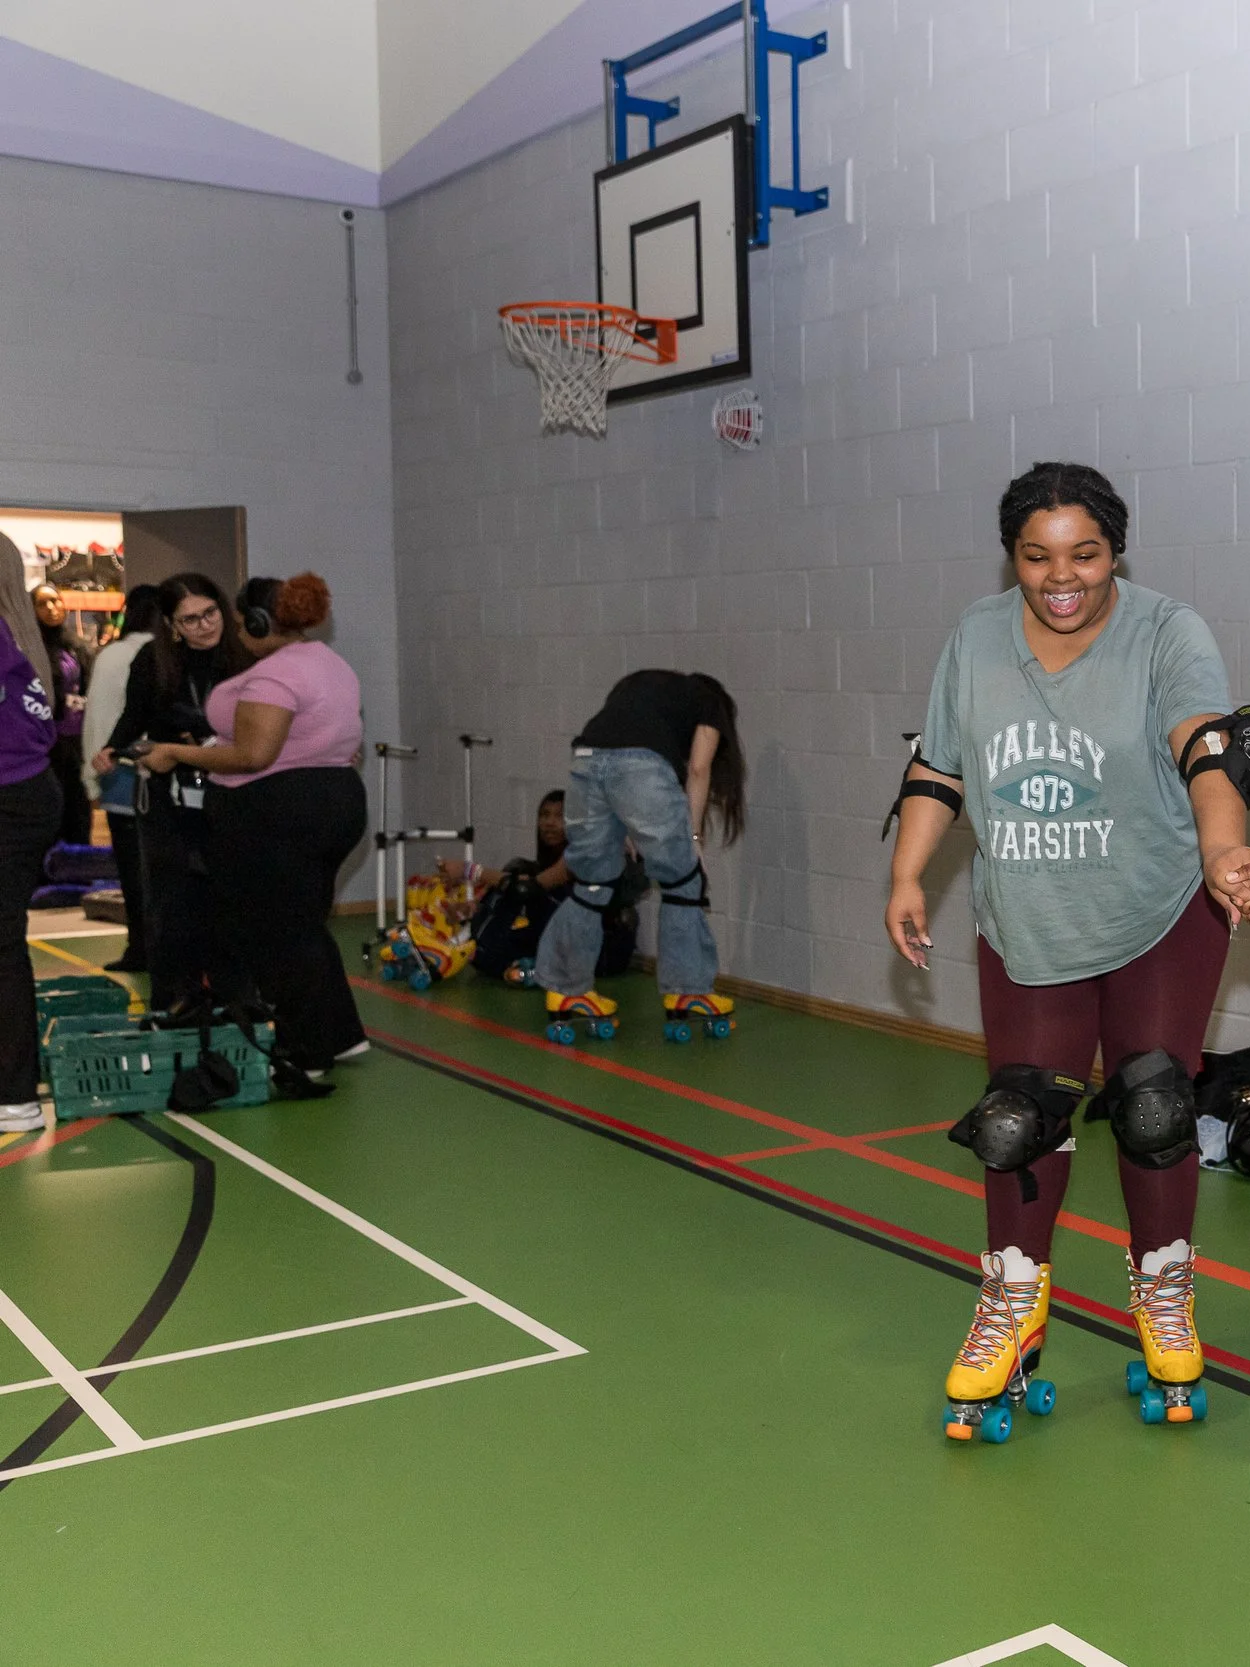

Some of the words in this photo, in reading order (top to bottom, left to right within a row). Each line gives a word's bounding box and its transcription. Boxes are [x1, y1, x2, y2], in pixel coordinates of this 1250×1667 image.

[985, 719, 1106, 784] VALLEY
[1019, 774, 1074, 813] 1973
[987, 818, 1114, 861] VARSITY
